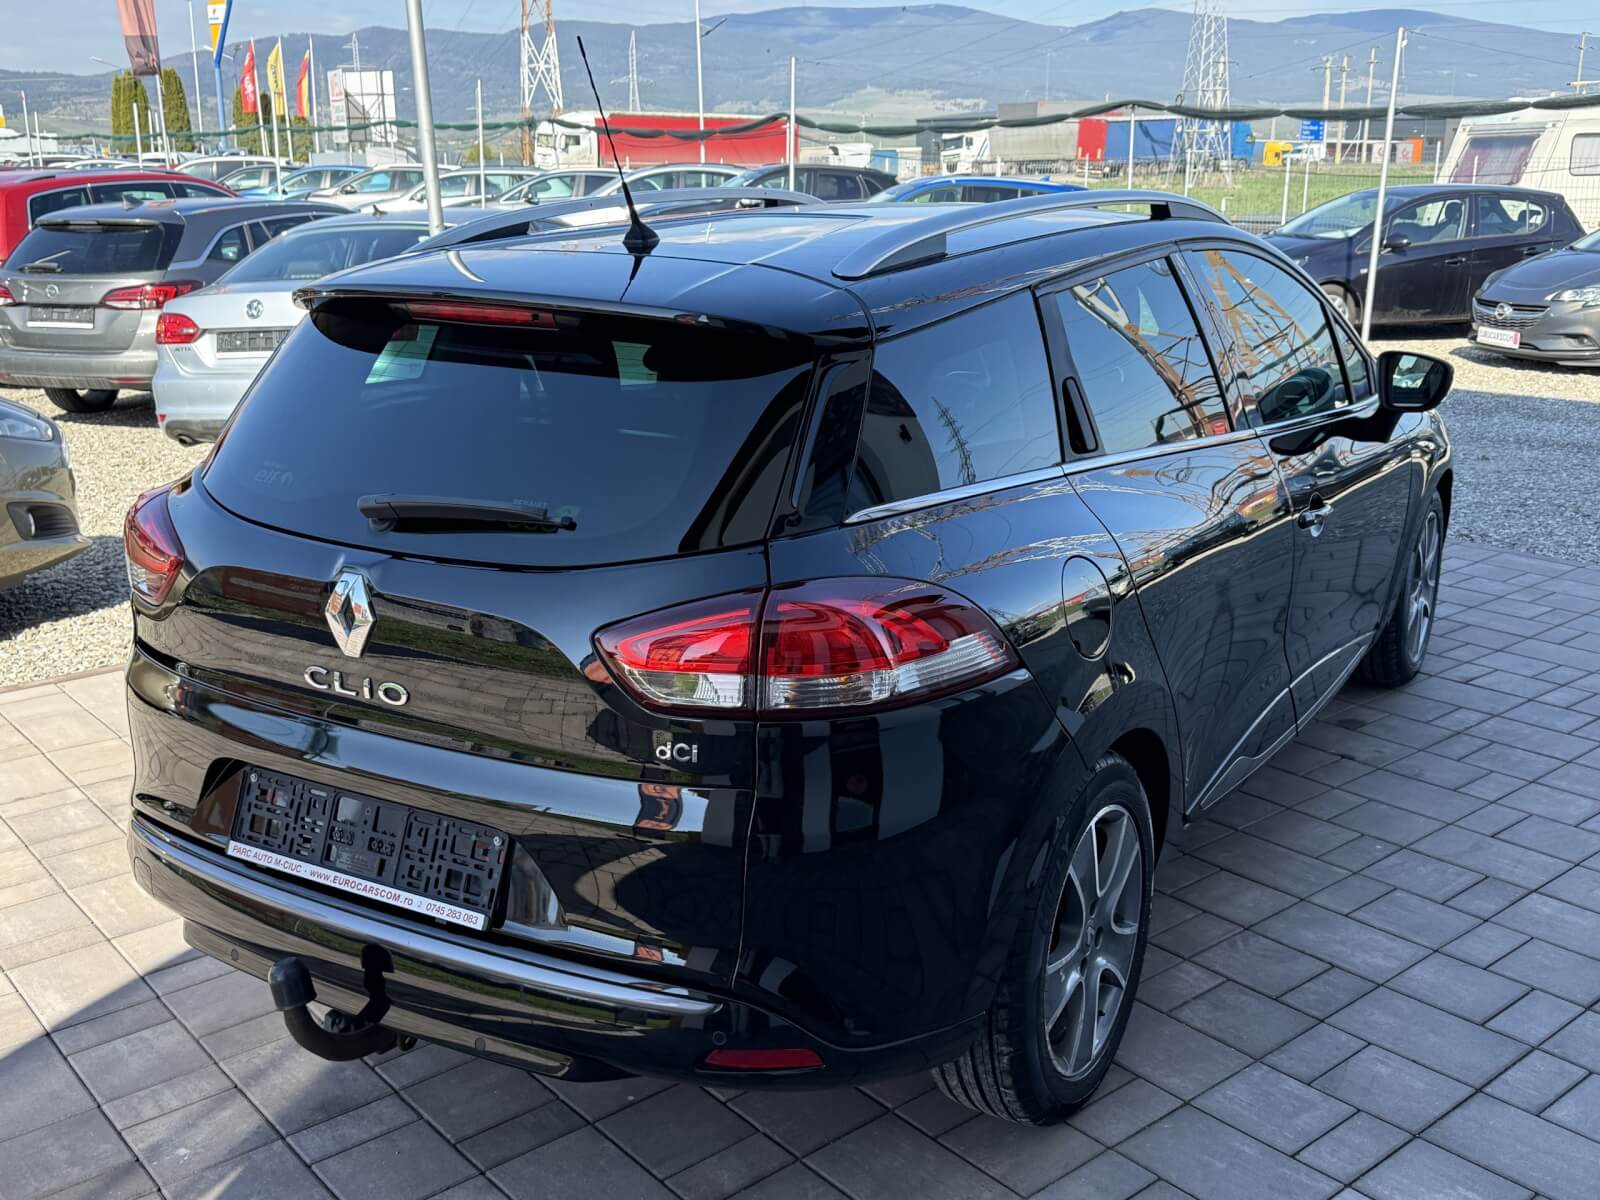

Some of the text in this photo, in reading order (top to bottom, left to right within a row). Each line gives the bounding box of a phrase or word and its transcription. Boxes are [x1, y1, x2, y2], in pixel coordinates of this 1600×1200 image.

[304, 666, 409, 706] CLIO
[656, 741, 698, 763] dCi
[232, 845, 252, 858] PARC
[253, 851, 273, 864] AUTO
[274, 859, 302, 873] M-CIUC
[426, 903, 444, 915] 0745
[447, 908, 462, 919] 283
[463, 913, 478, 925] 083
